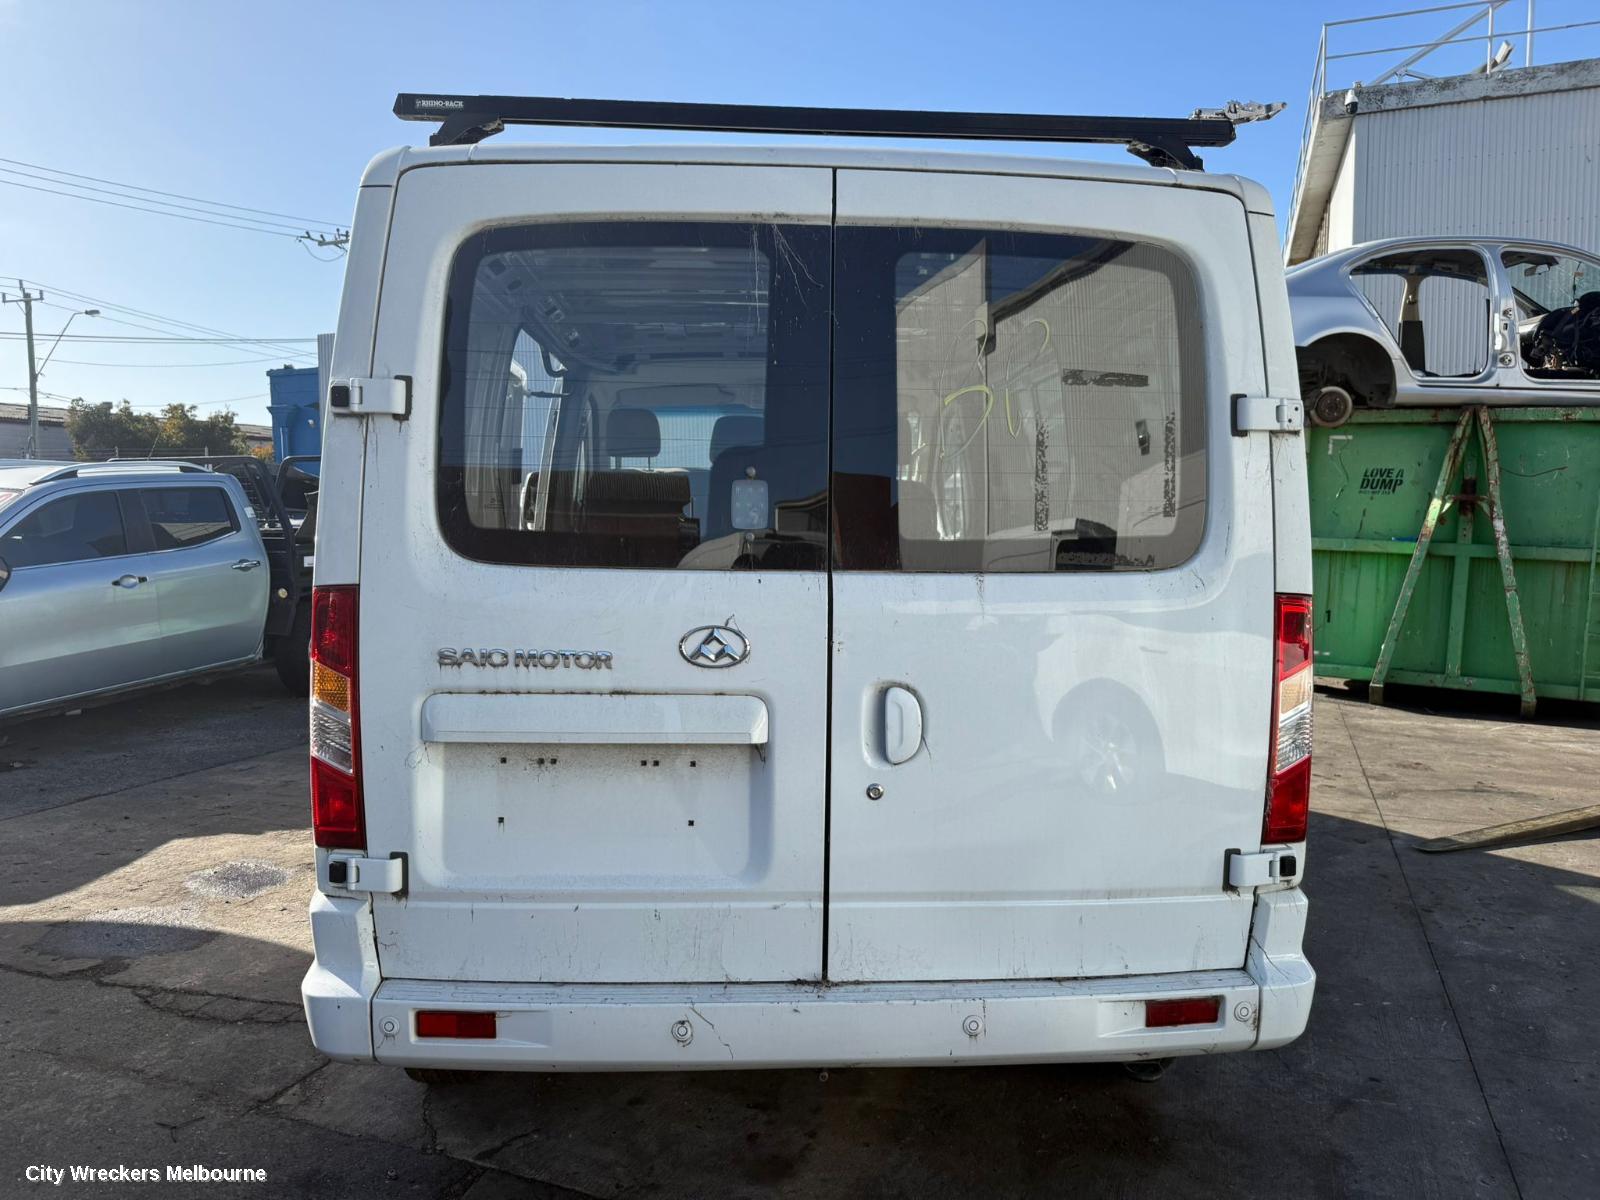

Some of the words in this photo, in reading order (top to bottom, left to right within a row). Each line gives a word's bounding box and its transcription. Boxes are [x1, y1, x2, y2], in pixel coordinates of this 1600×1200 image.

[421, 99, 464, 108] RHINO-RACK
[1363, 468, 1394, 478] LOVE
[1395, 468, 1405, 478] A
[1360, 478, 1404, 494] DUMP
[514, 648, 613, 670] MOTOR
